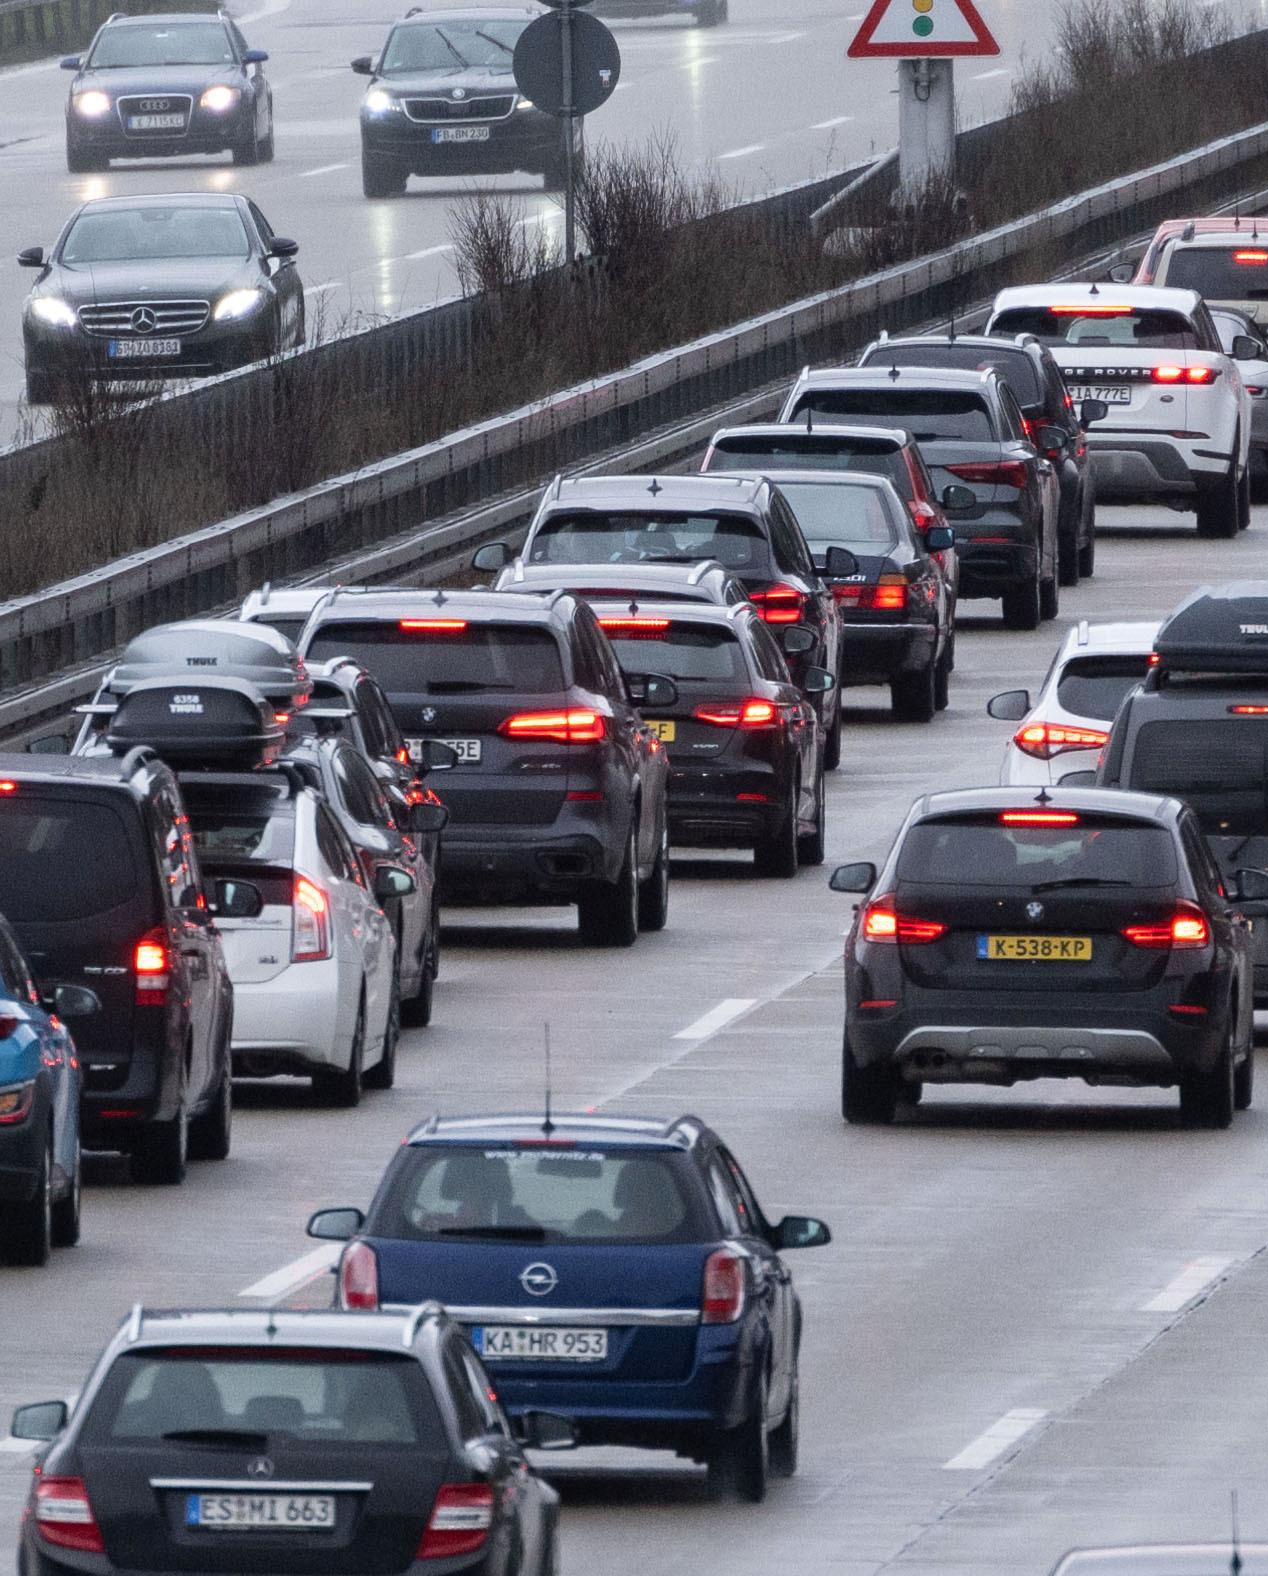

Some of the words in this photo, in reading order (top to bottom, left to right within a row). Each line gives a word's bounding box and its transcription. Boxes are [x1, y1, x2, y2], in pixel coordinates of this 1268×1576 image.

[1094, 368, 1152, 376] ROVER
[1095, 387, 1129, 400] 777E
[186, 656, 218, 666] THULE
[169, 703, 204, 714] THULE
[994, 939, 1085, 957] K-538-KP
[486, 1332, 513, 1352] KA
[529, 1332, 556, 1353] HR
[563, 1332, 604, 1354] 953
[202, 1498, 232, 1520] ES
[251, 1498, 278, 1521] MI
[286, 1498, 328, 1522] 663
